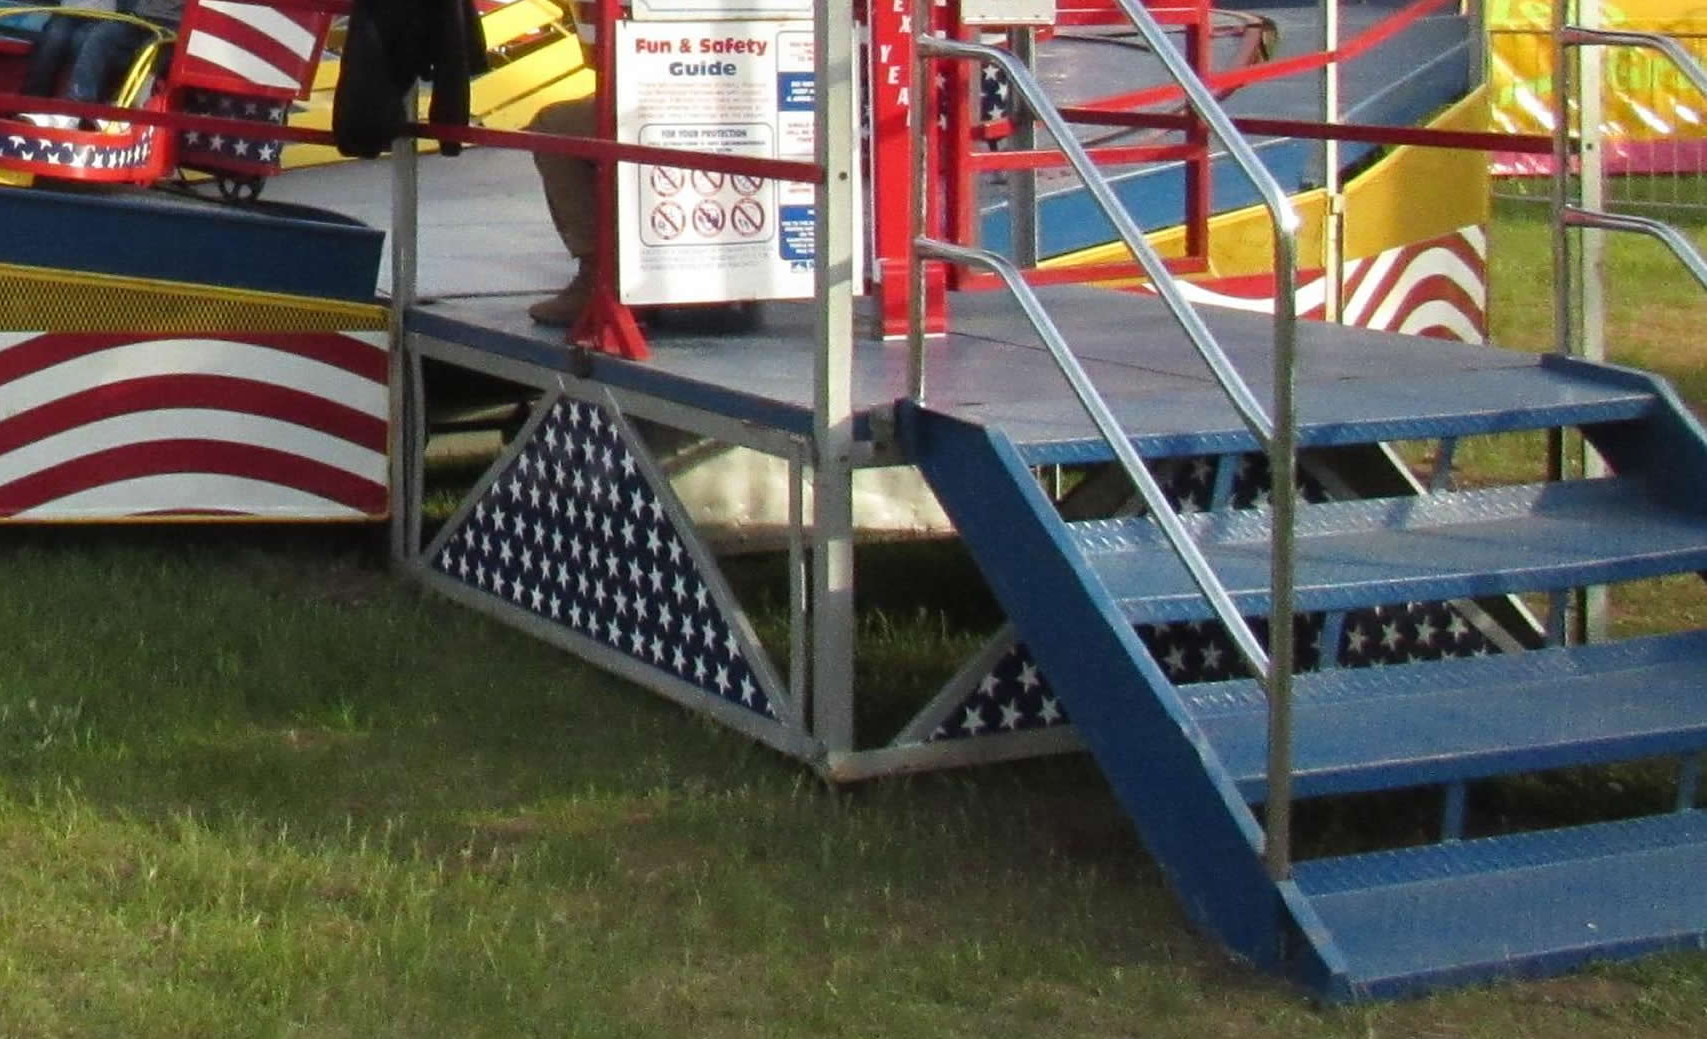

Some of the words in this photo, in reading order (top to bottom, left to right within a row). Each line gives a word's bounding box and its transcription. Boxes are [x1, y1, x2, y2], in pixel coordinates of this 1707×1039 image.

[635, 38, 671, 54] Fun
[679, 39, 691, 53] &
[699, 38, 768, 57] Safety
[669, 61, 737, 76] Guide
